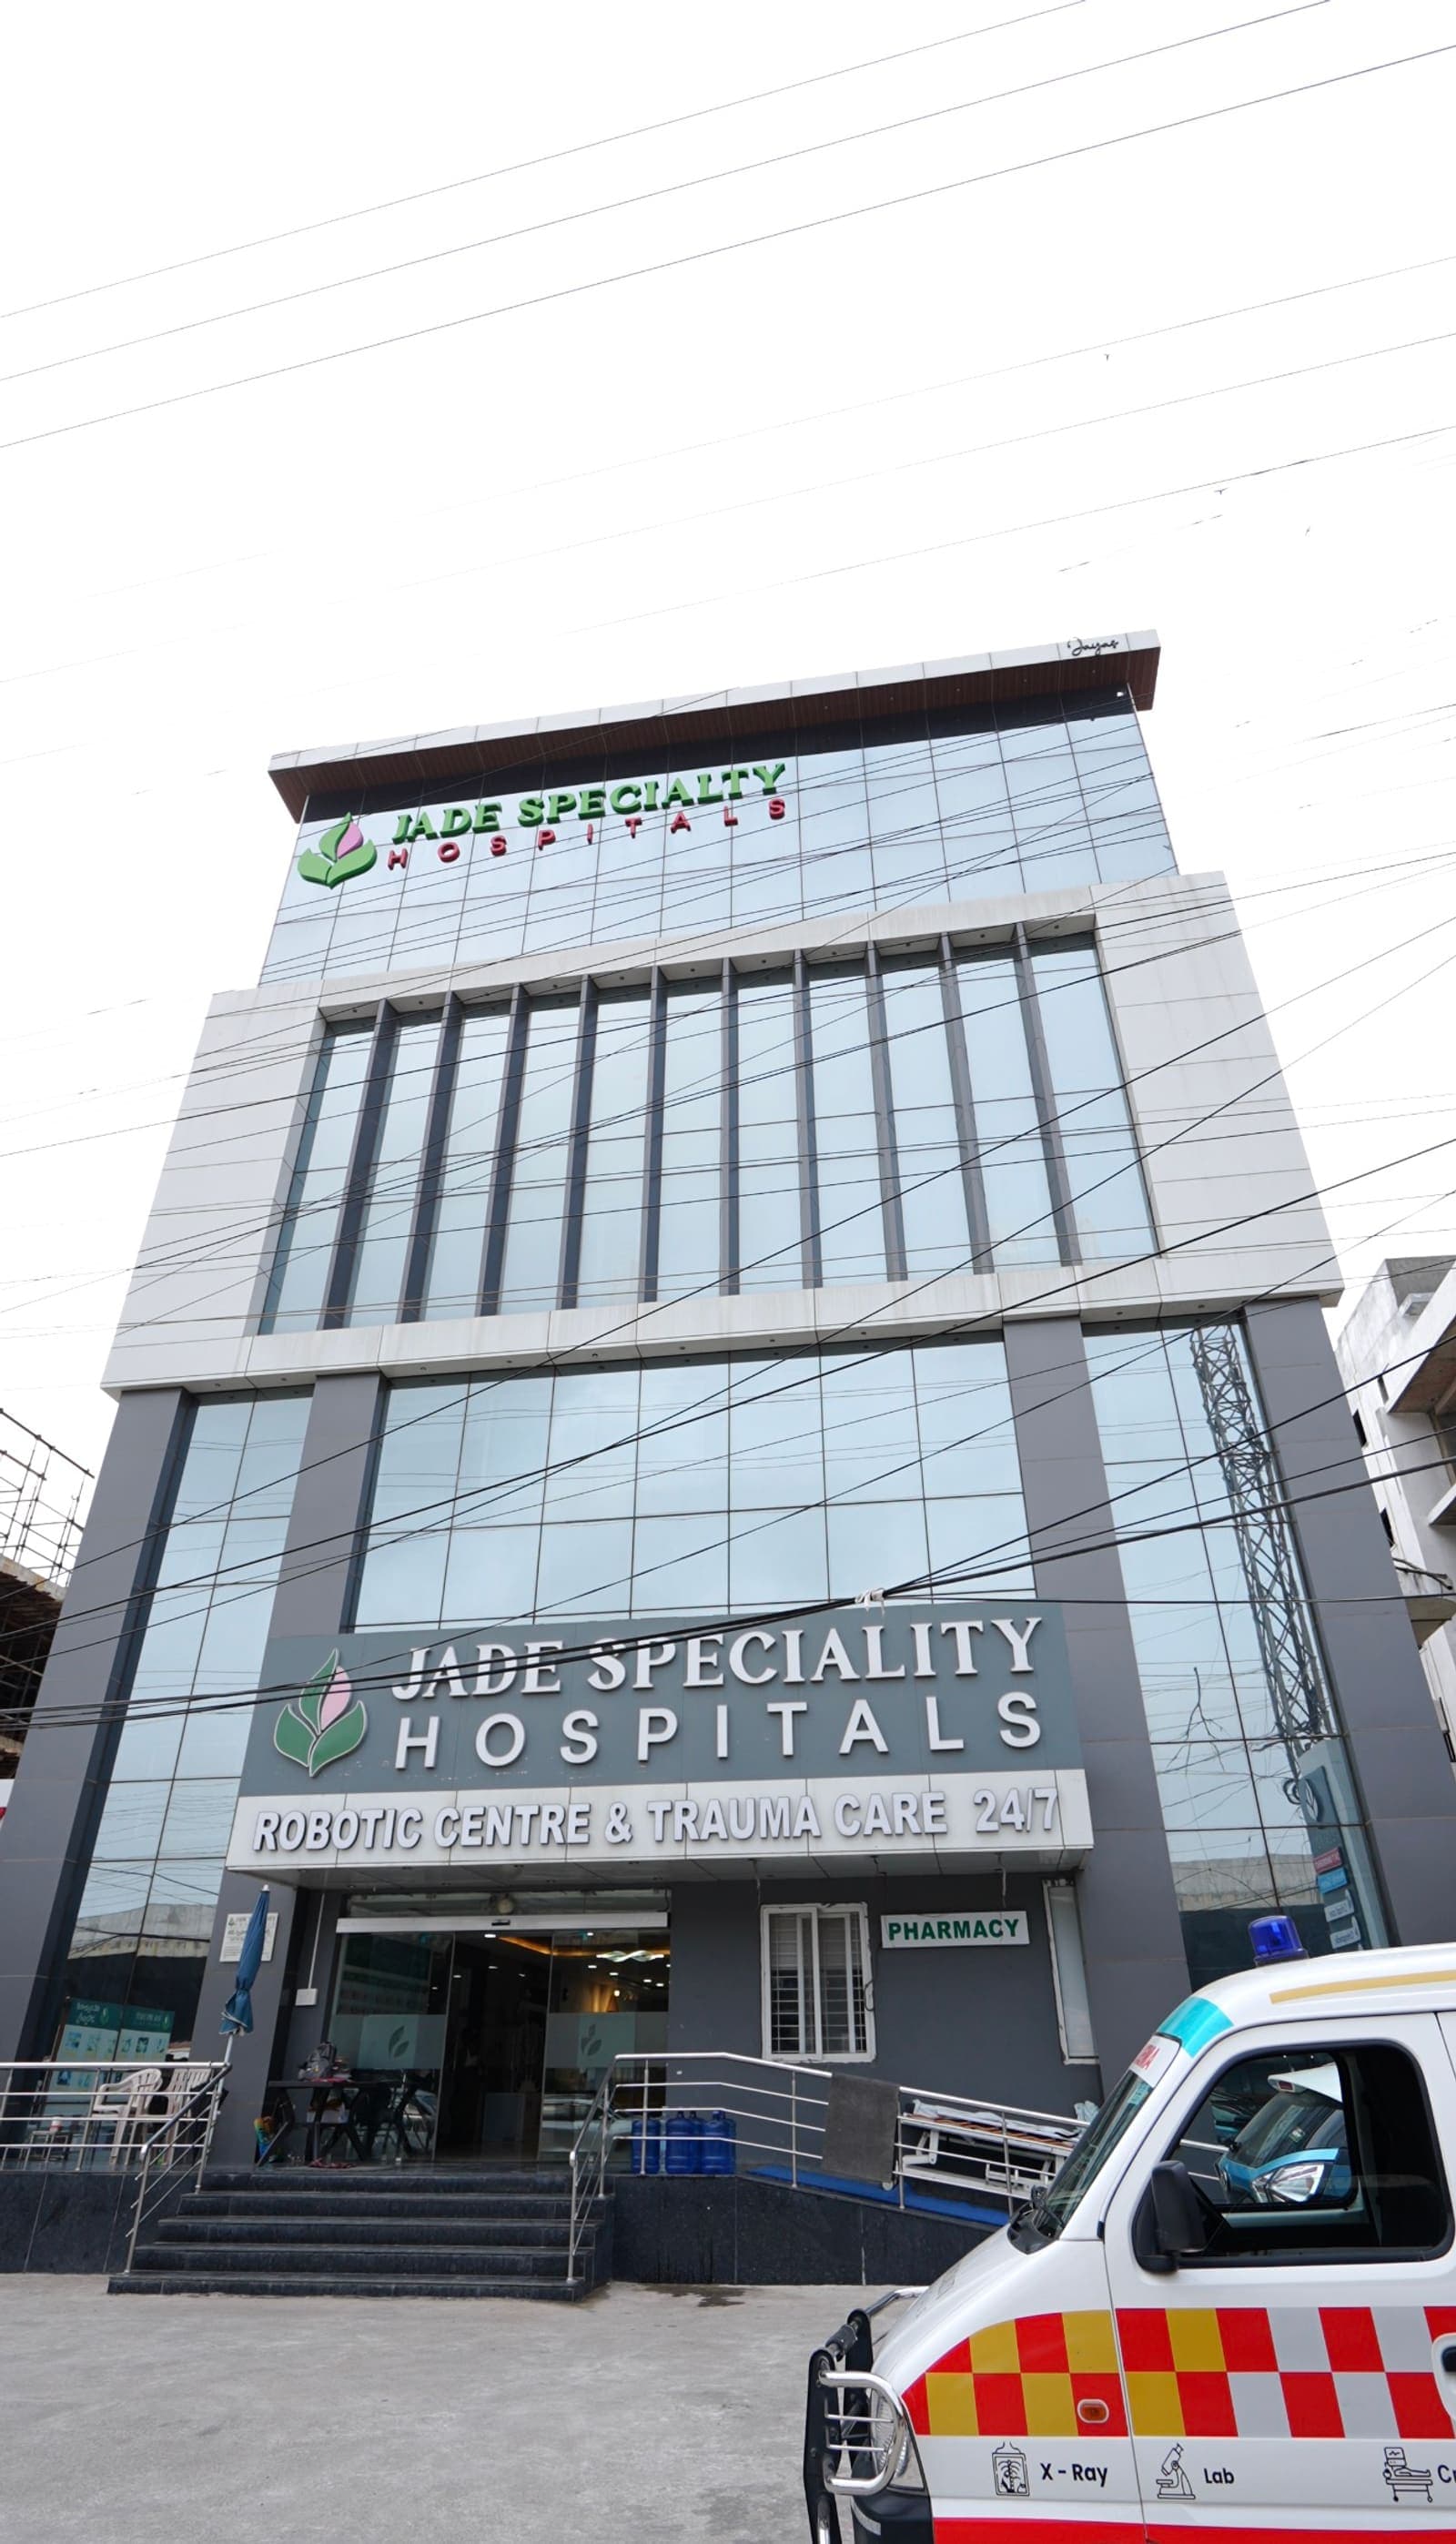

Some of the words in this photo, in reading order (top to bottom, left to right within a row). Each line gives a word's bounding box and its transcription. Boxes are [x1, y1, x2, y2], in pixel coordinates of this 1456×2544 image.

[388, 797, 785, 871] HOSPITALS
[392, 801, 502, 846] JADE
[518, 763, 785, 827] SPECIALTY
[391, 1640, 564, 1700] JADE
[587, 1617, 1042, 1691] SPECIALITY
[395, 1691, 1042, 1769] HOSPITALS
[253, 1808, 422, 1851] ROBOTIC
[433, 1803, 591, 1849] CENTRE
[604, 1800, 634, 1844] &
[647, 1795, 821, 1842] TRAUMA
[834, 1791, 948, 1838] CARE
[974, 1787, 1058, 1832] 24/7
[888, 1918, 1020, 1941] PHARMACY
[1040, 2463, 1053, 2481] X
[1072, 2464, 1108, 2488] Ray
[1203, 2468, 1235, 2485] Lab
